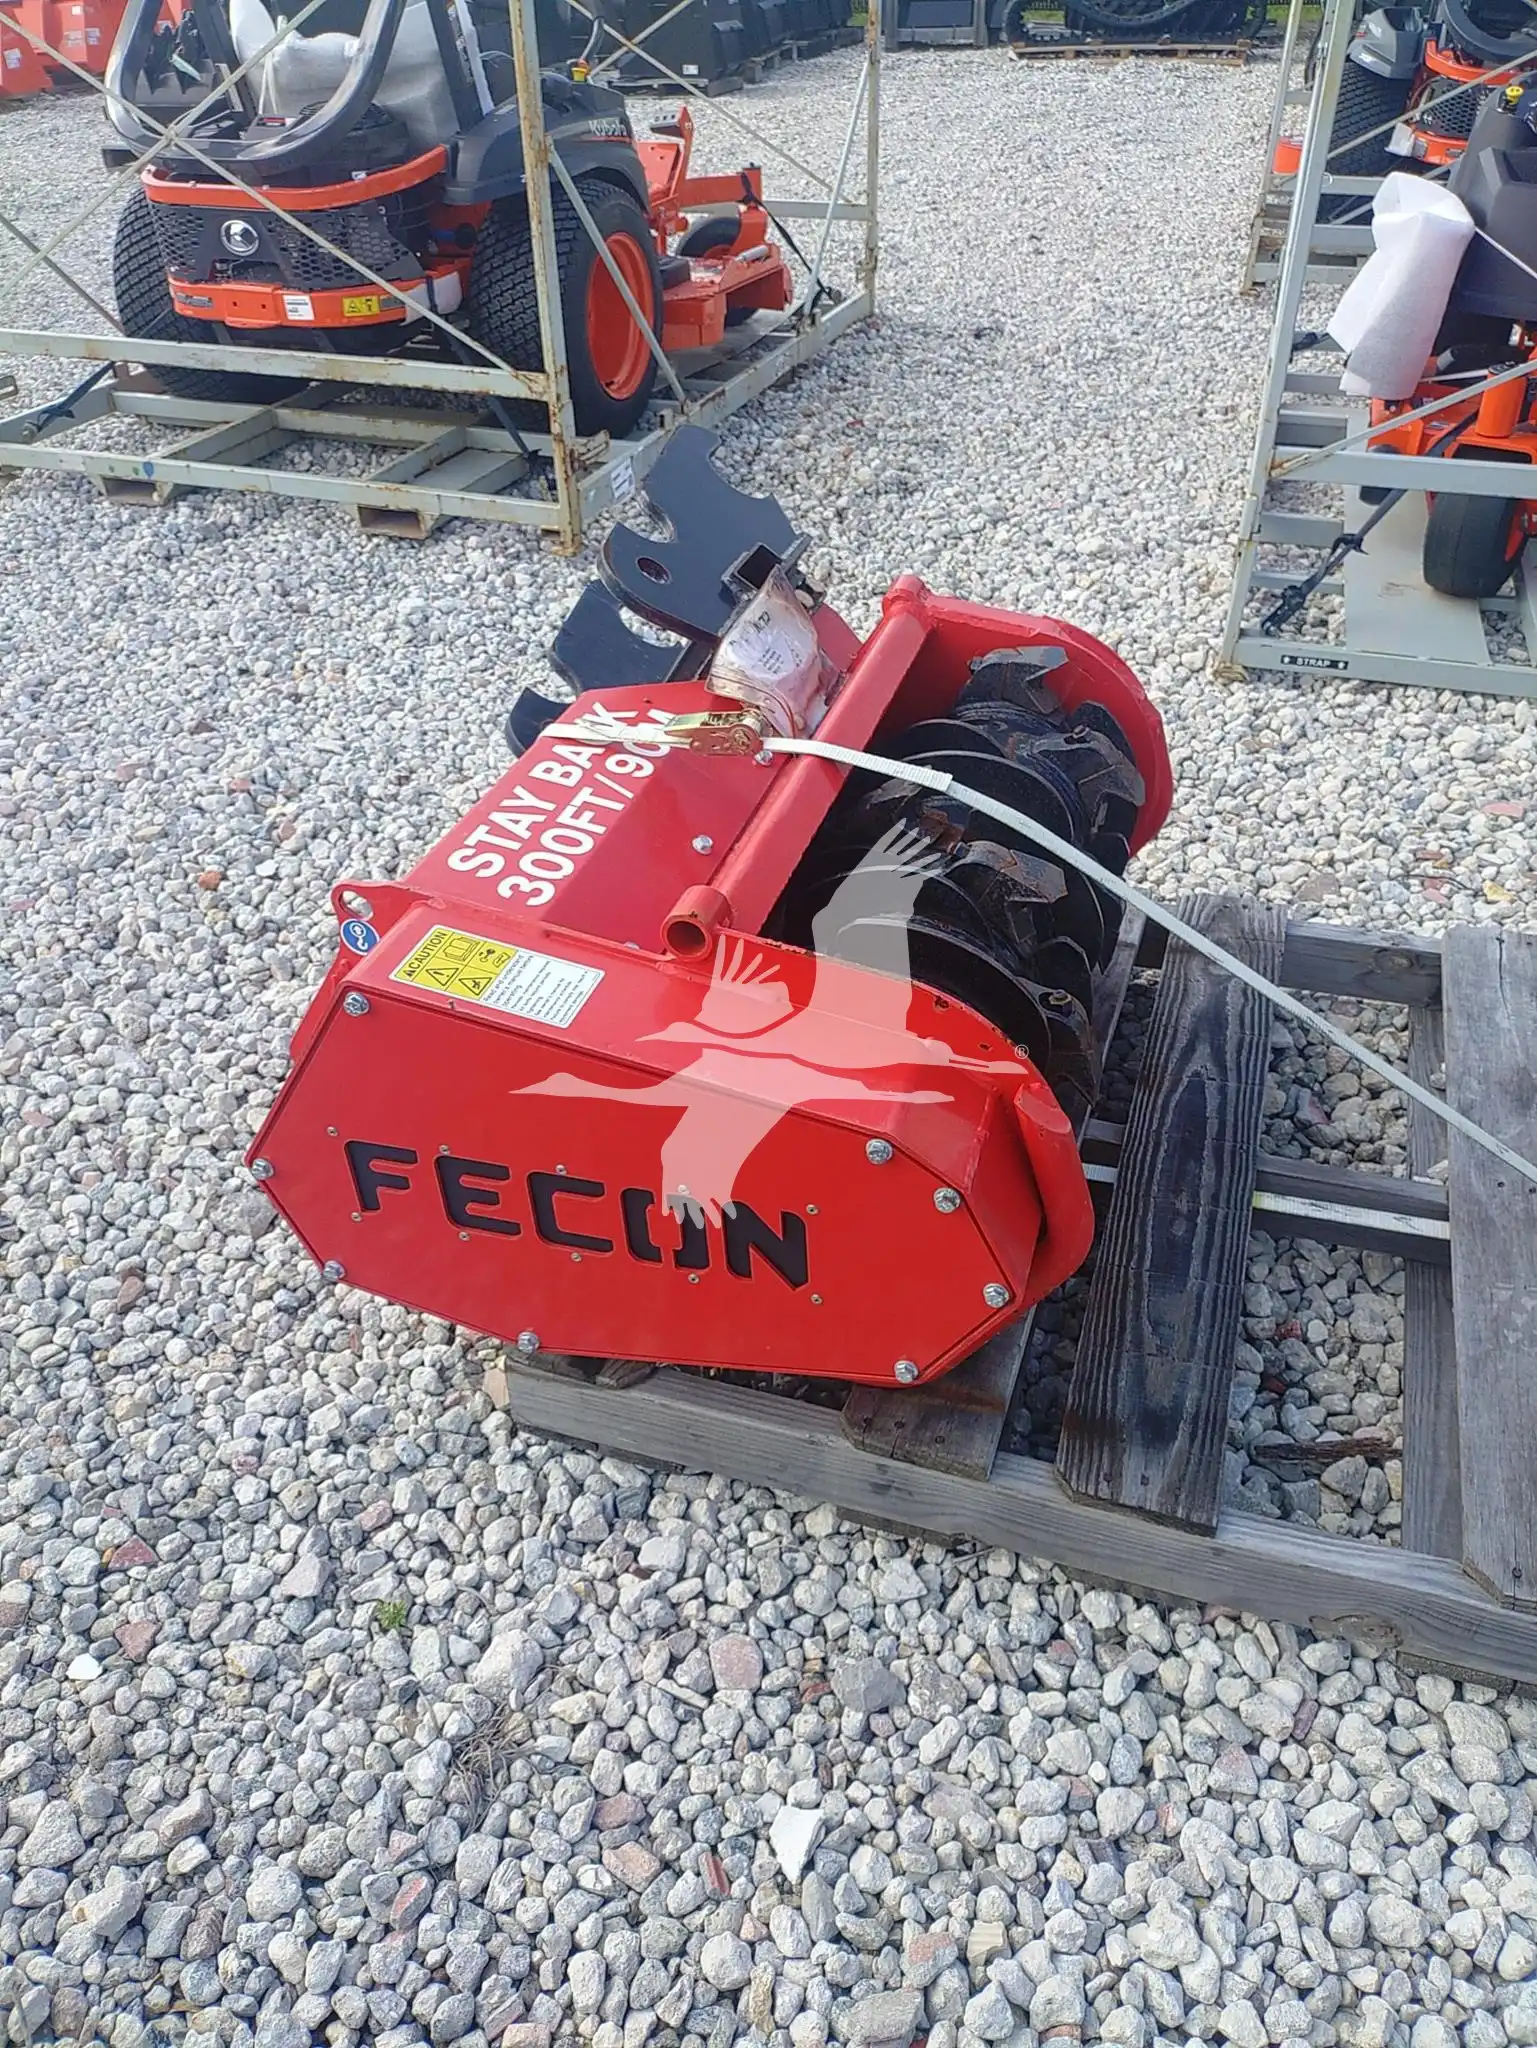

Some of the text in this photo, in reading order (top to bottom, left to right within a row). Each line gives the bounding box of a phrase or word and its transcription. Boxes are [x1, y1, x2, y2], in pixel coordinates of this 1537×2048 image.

[1296, 657, 1331, 668] STRAP
[447, 785, 557, 878] STAY
[408, 930, 448, 970] CAUTION
[344, 1139, 810, 1291] FECON
